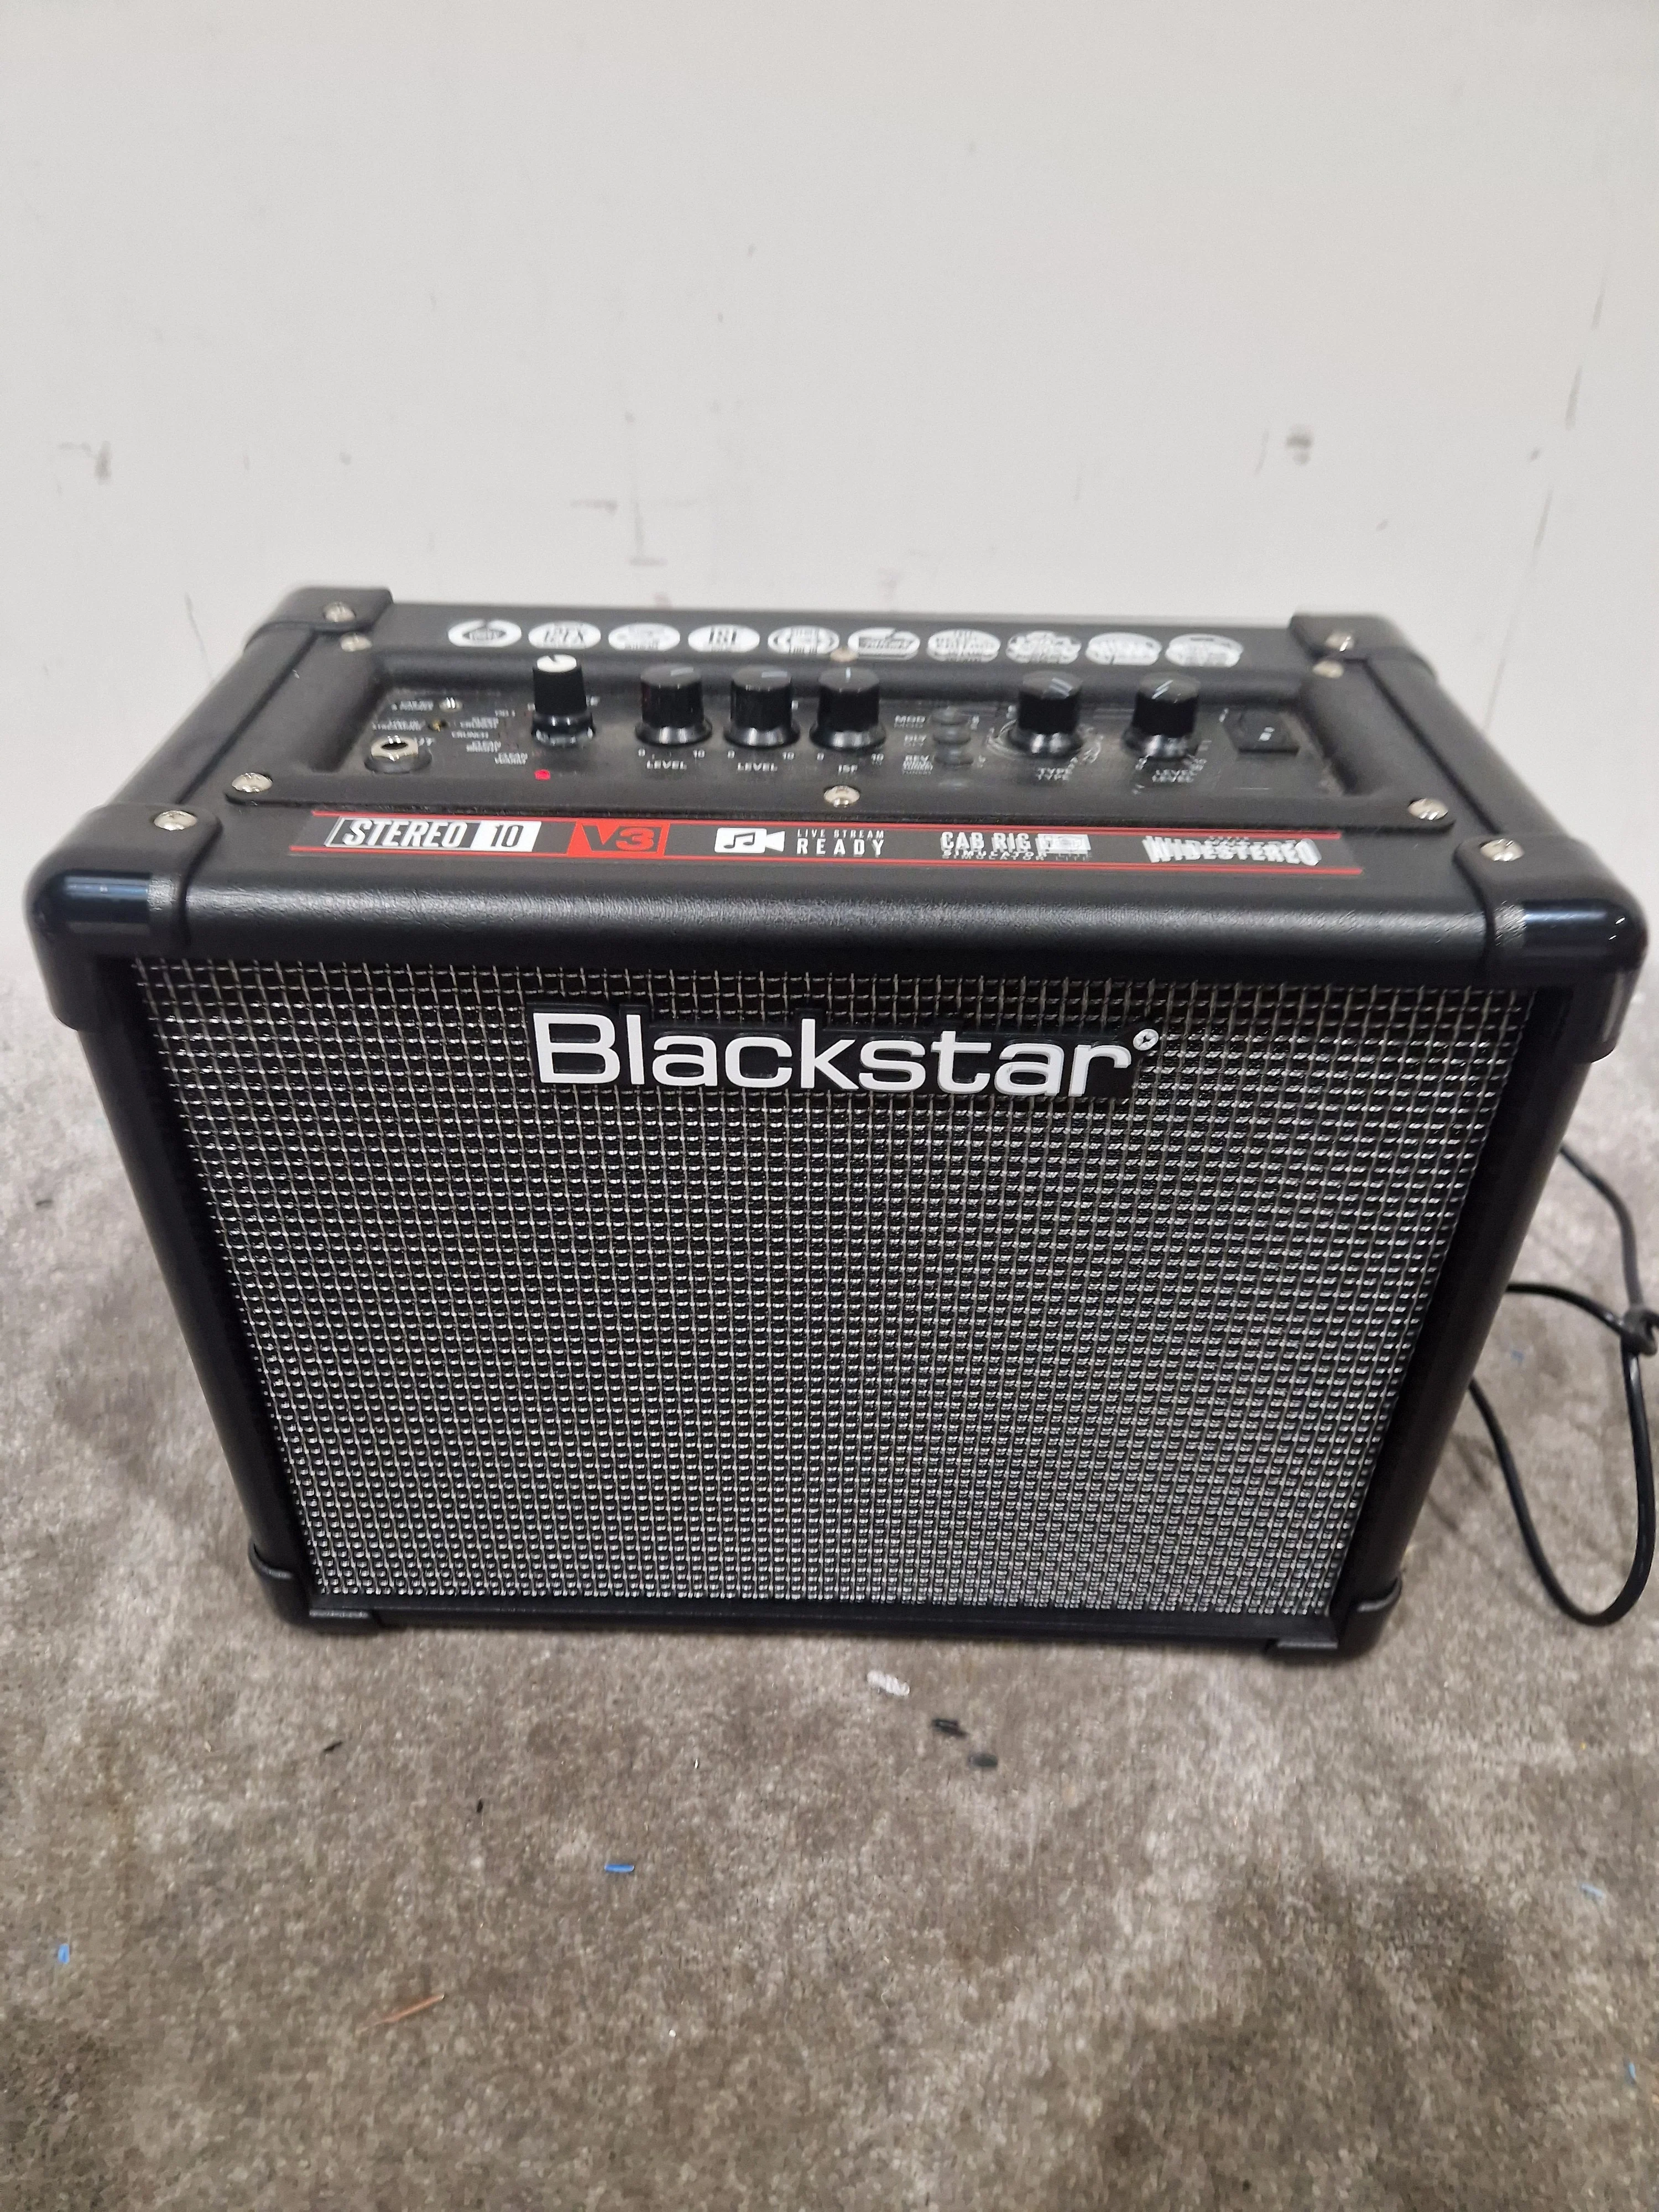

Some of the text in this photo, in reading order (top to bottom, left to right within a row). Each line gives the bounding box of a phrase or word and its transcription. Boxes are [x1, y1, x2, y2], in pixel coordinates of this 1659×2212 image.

[646, 759, 687, 770] LEVEL
[737, 761, 778, 772] LEVEL
[343, 817, 525, 847] STEREO 10
[581, 824, 655, 852] V3
[797, 828, 884, 839] LIVE STREAM
[940, 831, 1032, 853] CAB RIG
[796, 838, 885, 857] READY
[533, 1011, 1133, 1098] Blackstar
